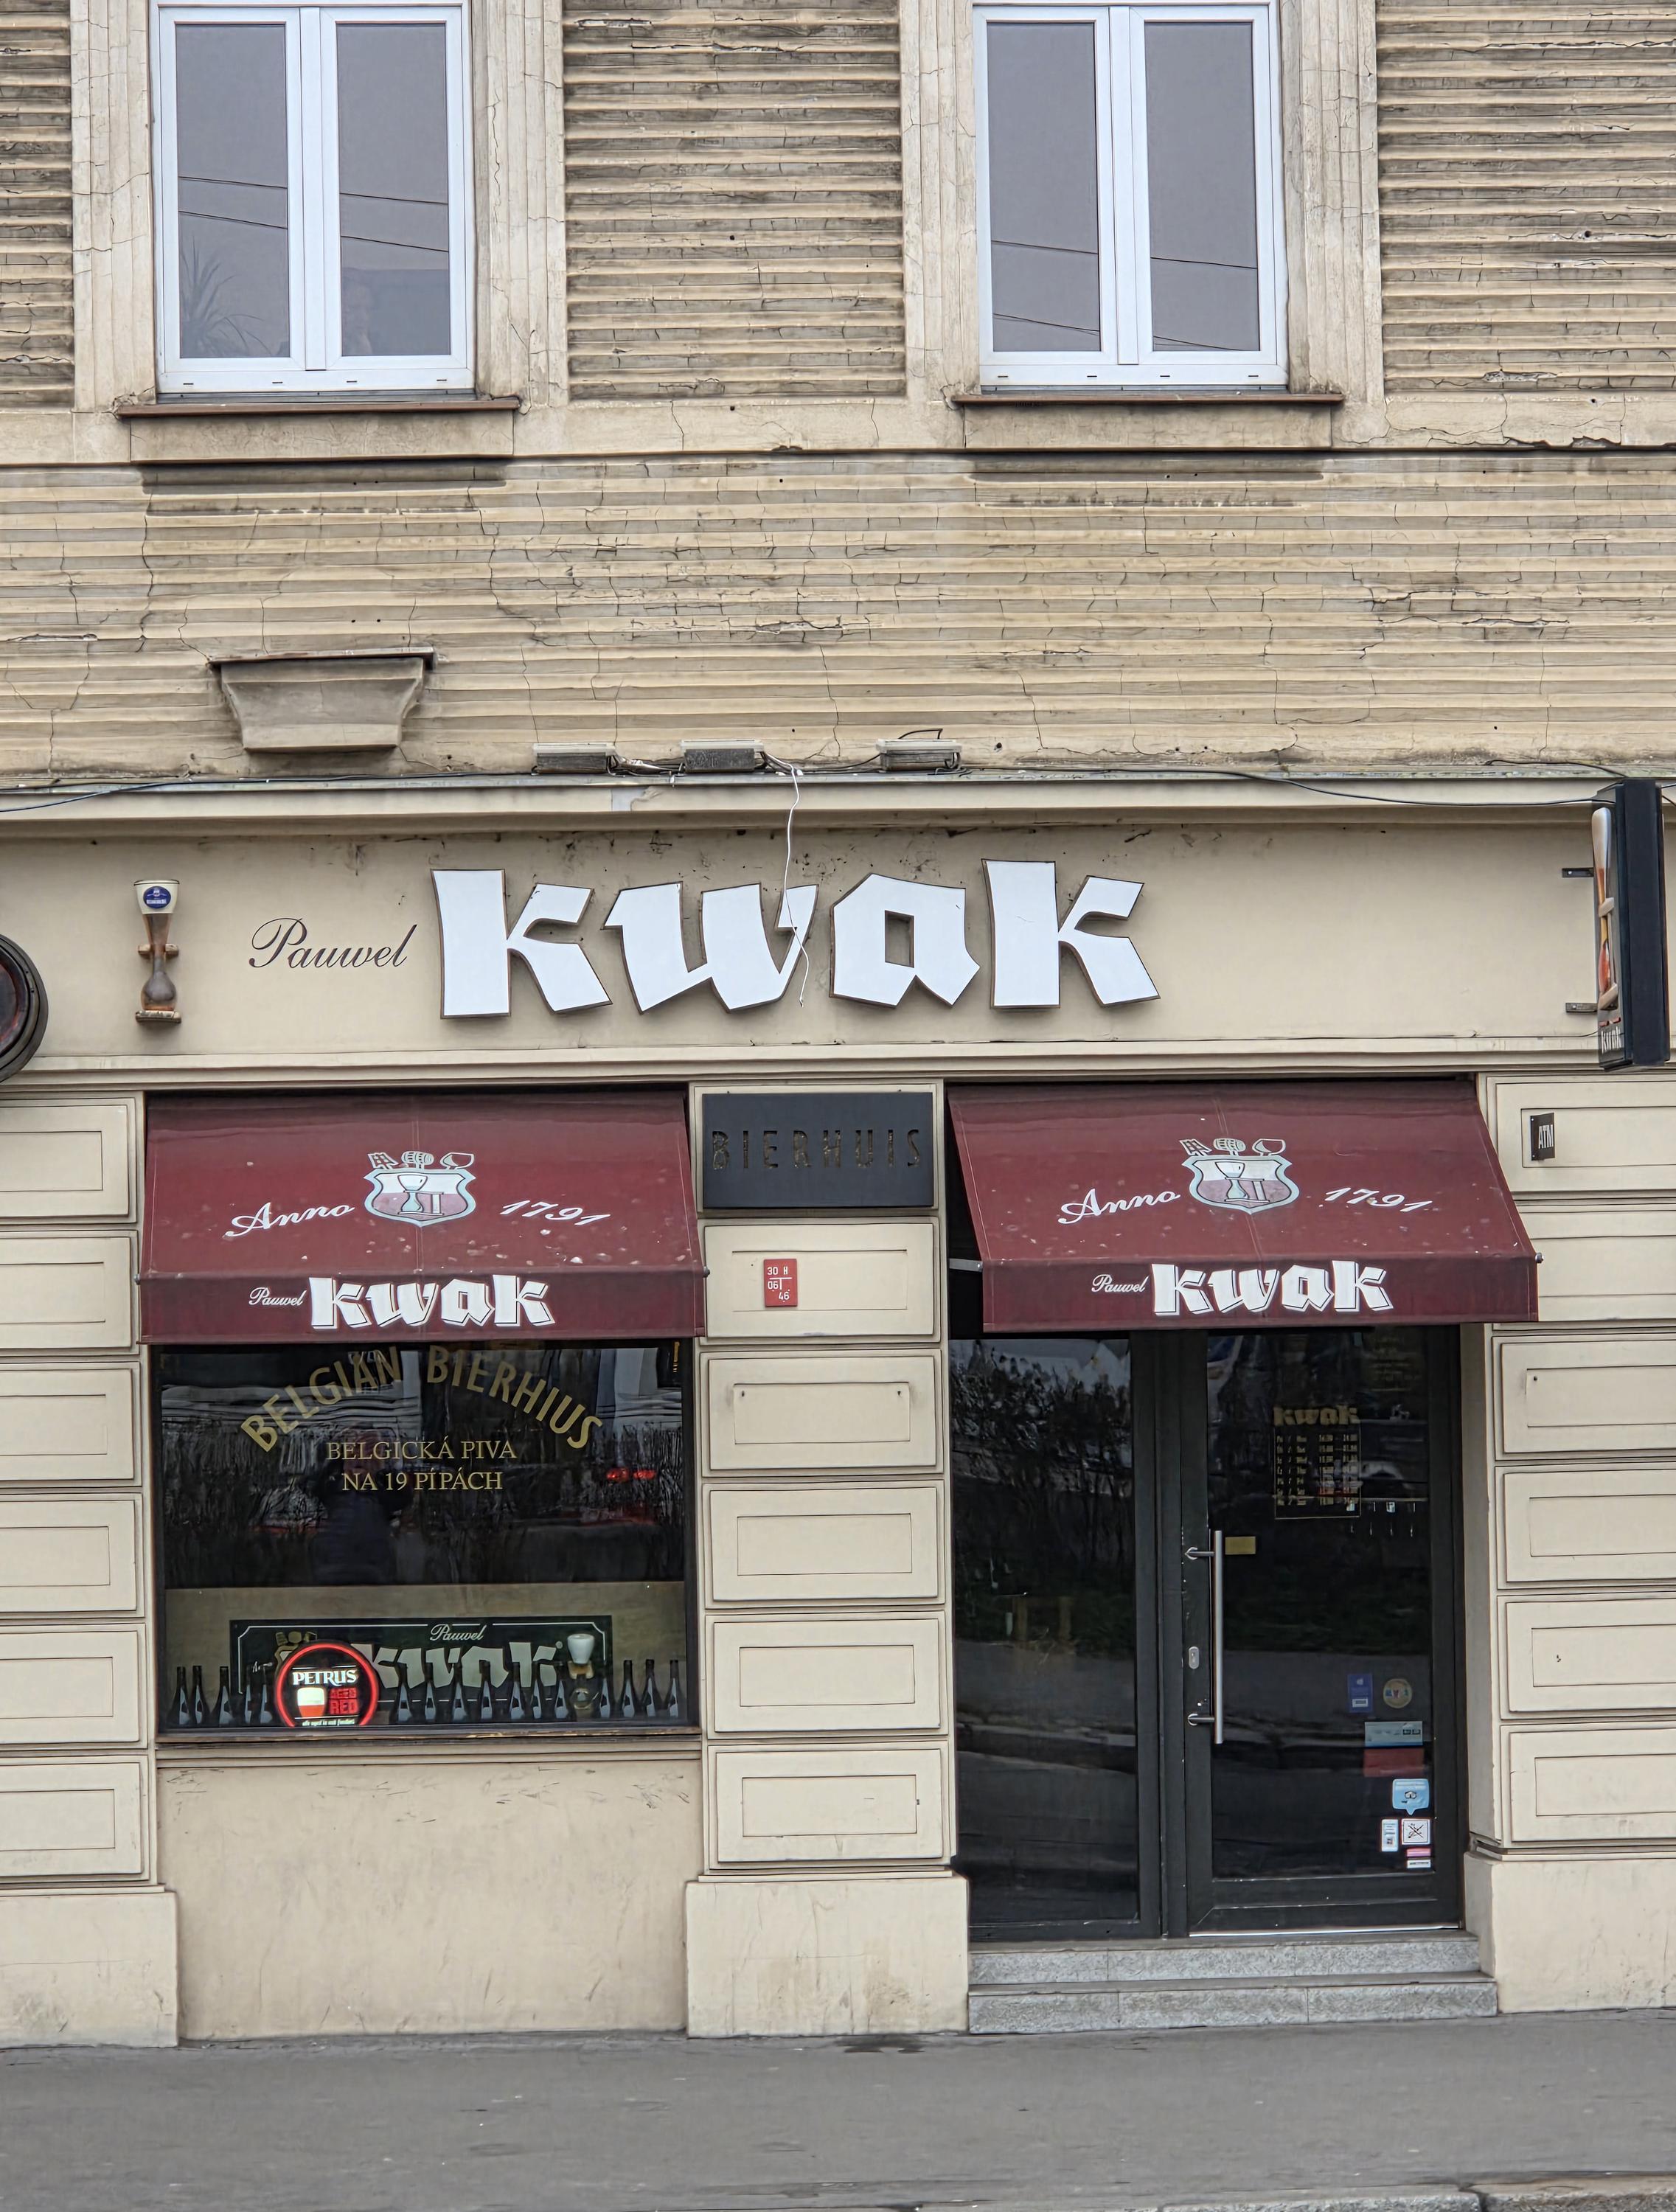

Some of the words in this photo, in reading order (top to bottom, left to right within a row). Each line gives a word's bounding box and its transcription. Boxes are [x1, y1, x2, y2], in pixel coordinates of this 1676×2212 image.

[248, 917, 418, 970] Pauwel
[430, 858, 1160, 1019] kwak
[712, 1129, 922, 1171] BIERHUIS
[1538, 1124, 1554, 1150] ATM
[224, 1201, 356, 1237] Anno
[499, 1199, 611, 1227] 1791
[1058, 1188, 1181, 1224] Anno
[1324, 1186, 1433, 1213] 1791
[767, 1266, 779, 1276] 30
[783, 1266, 788, 1276] H
[1091, 1273, 1150, 1293] Pauwel
[1151, 1259, 1394, 1316] kwak
[248, 1286, 307, 1307] Pauwel
[308, 1274, 556, 1329] kwak
[240, 1346, 403, 1453] BELGIAN
[426, 1344, 603, 1450] BIERHIUS
[1273, 1404, 1360, 1426] kwak
[326, 1436, 455, 1461] BELGICKÁ
[461, 1440, 518, 1460] PIVA
[341, 1472, 378, 1491] NA
[385, 1472, 408, 1491] 19
[414, 1467, 504, 1491] PÍPÁCH
[429, 1624, 487, 1641] Pauwel
[292, 1669, 358, 1687] PETRUS
[329, 1699, 359, 1716] RED
